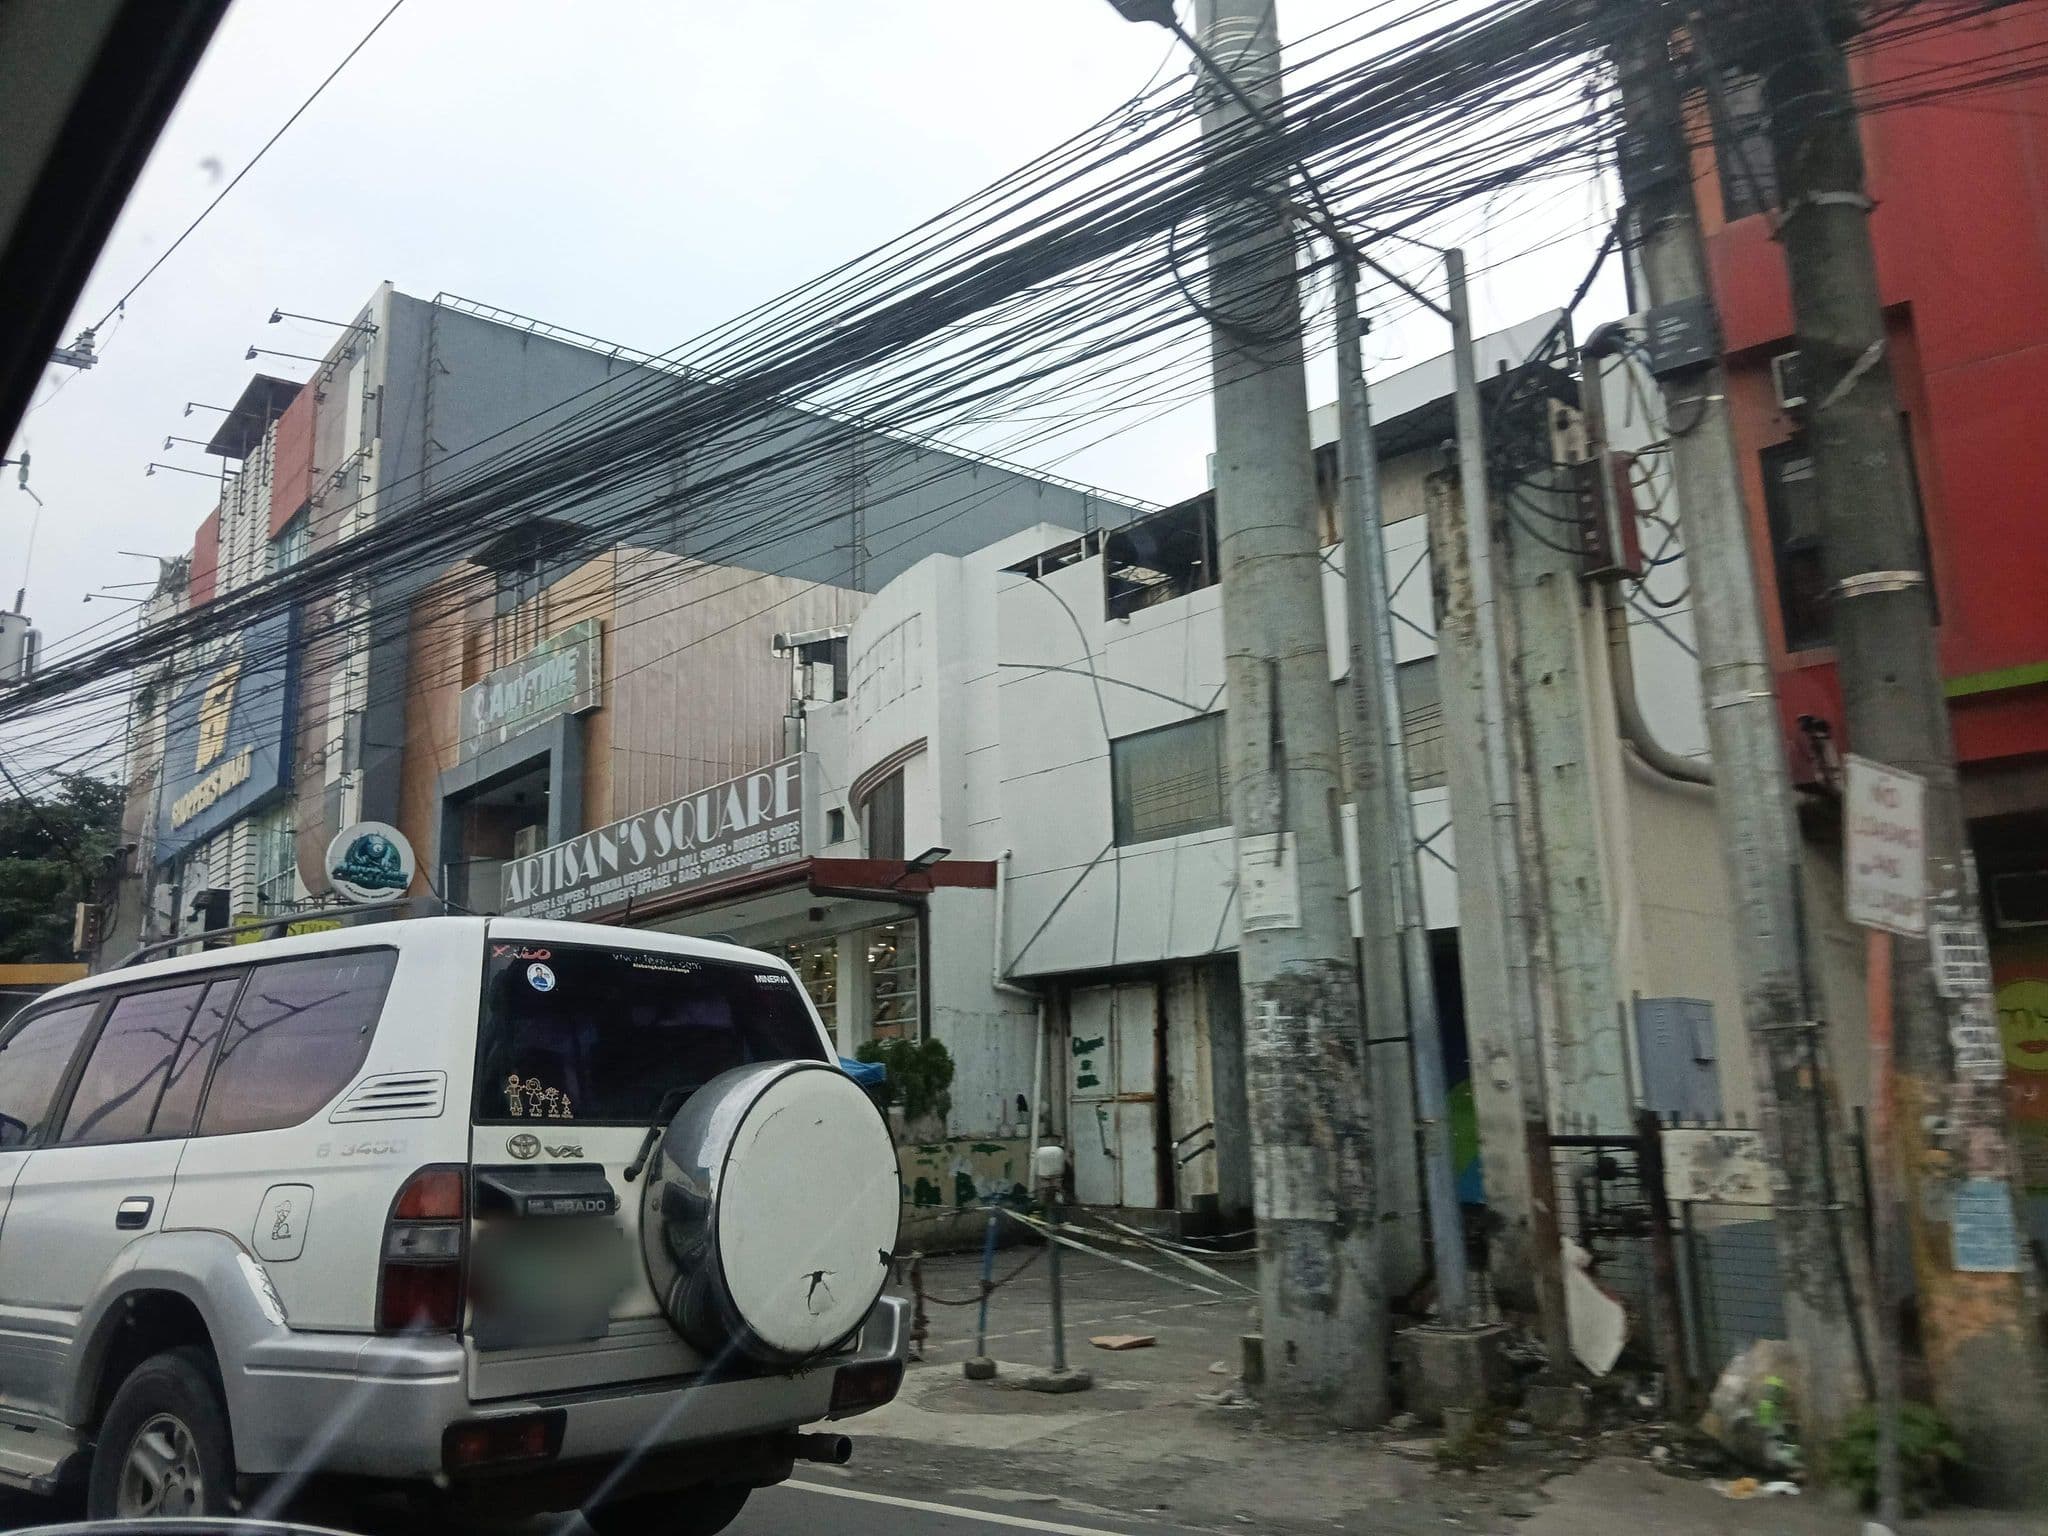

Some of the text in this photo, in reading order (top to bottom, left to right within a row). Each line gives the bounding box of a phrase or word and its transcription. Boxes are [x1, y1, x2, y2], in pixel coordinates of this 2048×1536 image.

[489, 647, 577, 721] ANYTIME
[504, 760, 800, 906] ARTISAN'S SQUARE
[700, 843, 727, 863] SHOES
[769, 820, 800, 841] SHOES
[754, 974, 790, 985] MINERVA
[544, 1145, 584, 1158] VX
[552, 1199, 606, 1213] PRADO
